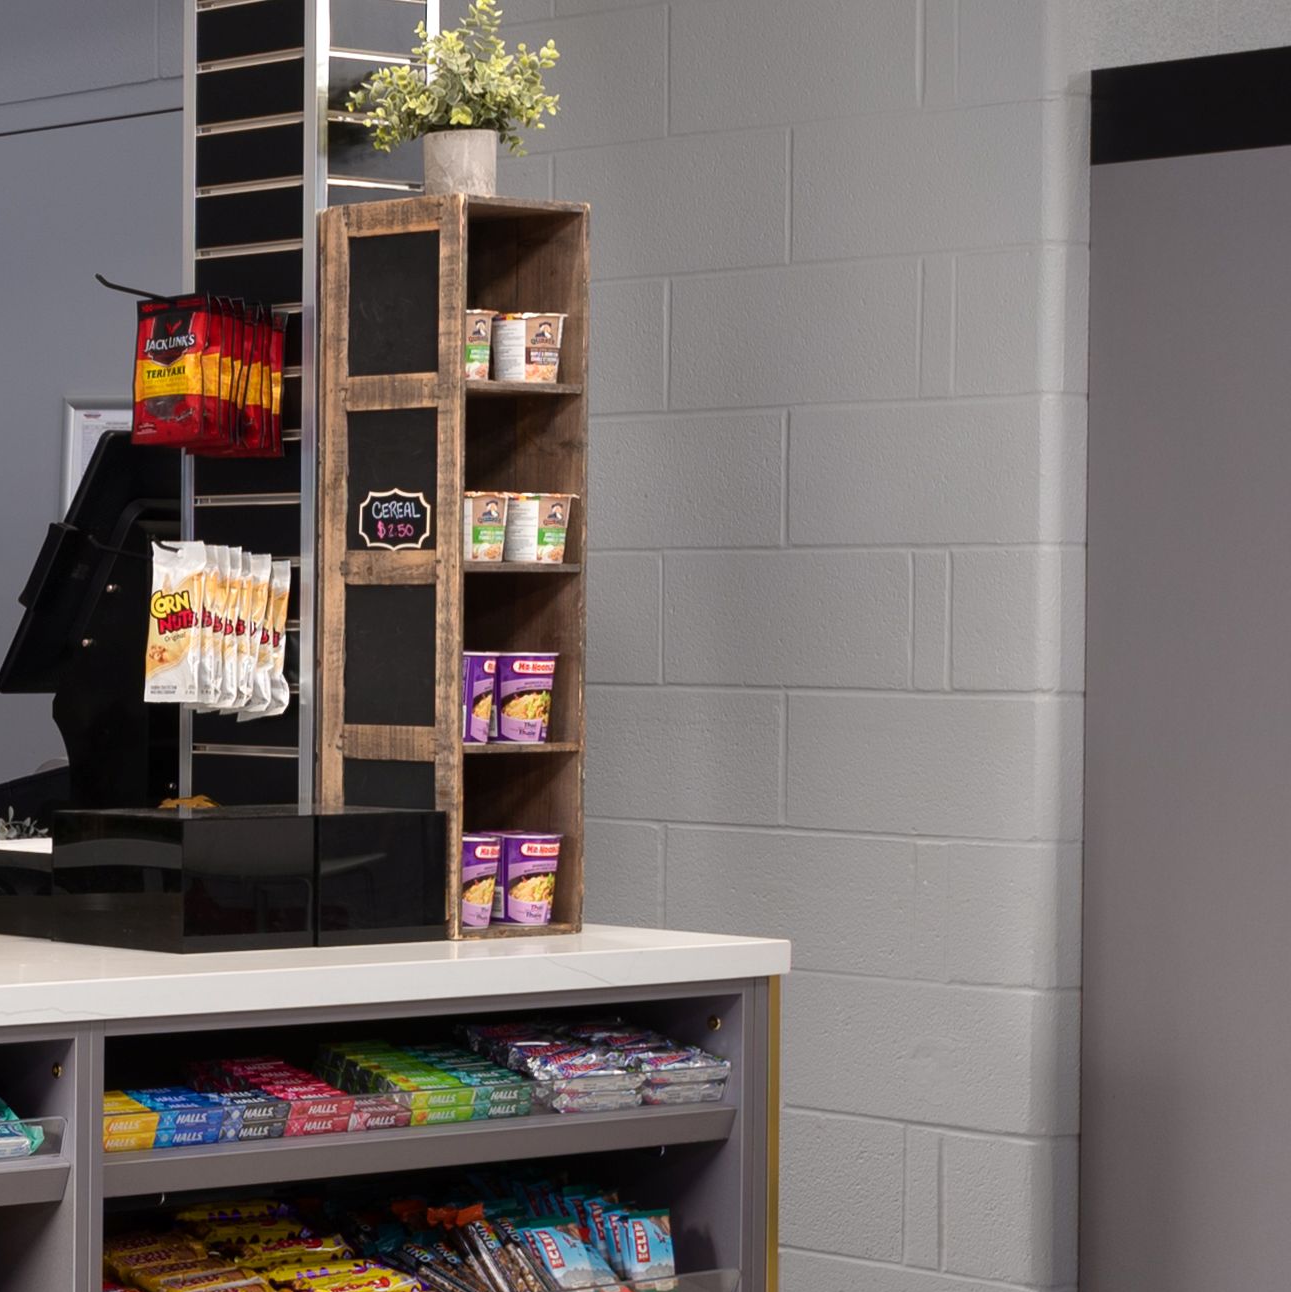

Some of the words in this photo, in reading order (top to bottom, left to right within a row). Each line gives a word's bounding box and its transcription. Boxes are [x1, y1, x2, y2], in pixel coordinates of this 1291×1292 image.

[144, 338, 168, 352] JACK
[168, 334, 195, 349] LINK'S
[146, 366, 185, 379] TERIYAKI
[371, 500, 421, 519] CEREAL
[150, 590, 192, 618] CORN
[164, 632, 186, 643] Original
[242, 1106, 274, 1120] HALLS
[307, 1102, 338, 1115] HALLS
[176, 1111, 208, 1124] HALLS
[303, 1118, 333, 1132] HALLS
[172, 1131, 203, 1144] HALLS
[238, 1125, 269, 1138] HALLS
[471, 1219, 499, 1256] KIND
[633, 1222, 649, 1254] CLIF
[402, 1242, 434, 1264] KIND
[432, 1242, 460, 1265] KIND
[538, 1231, 561, 1261] CLIF
